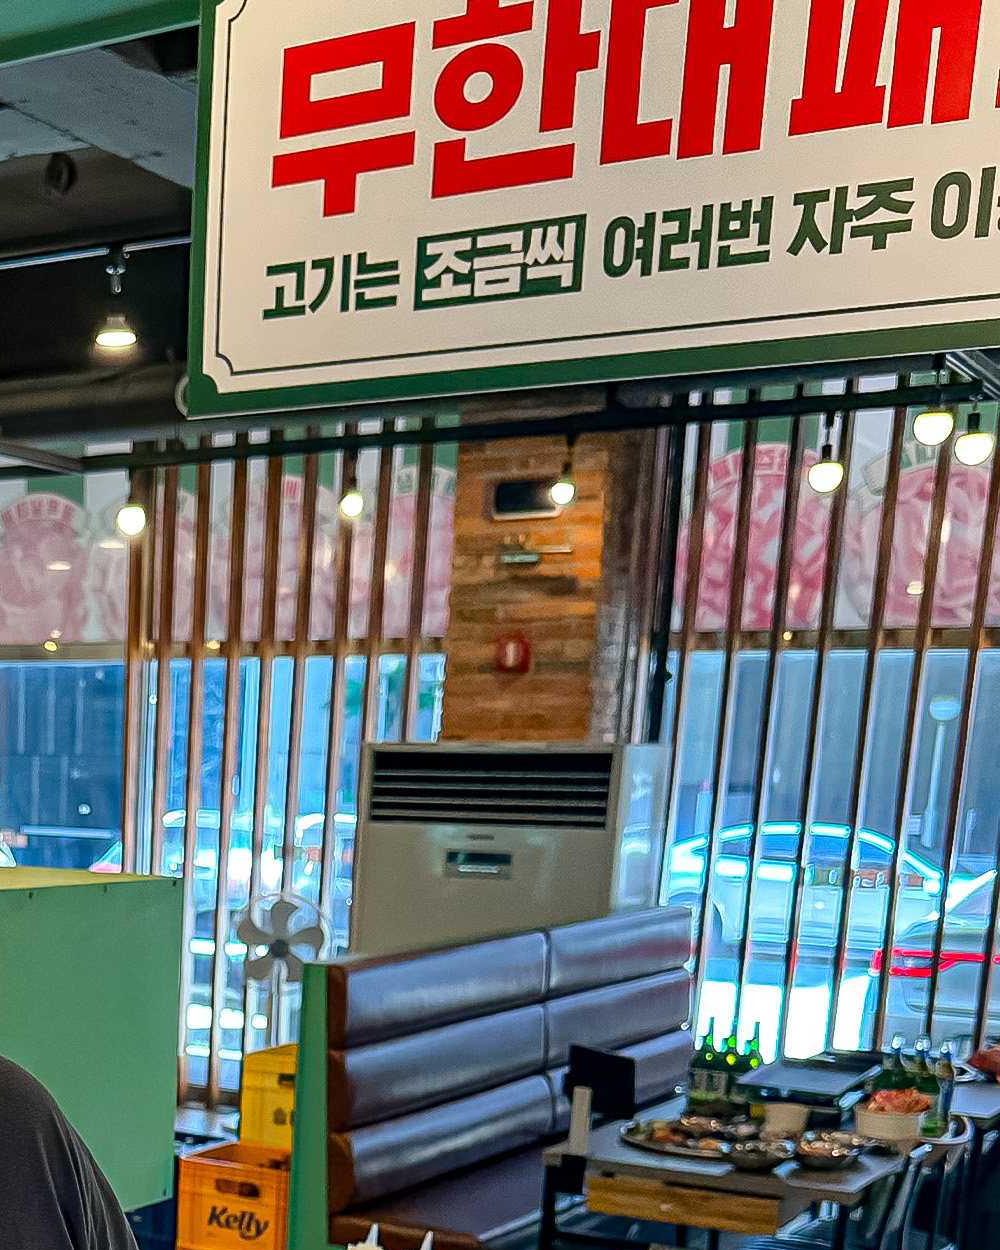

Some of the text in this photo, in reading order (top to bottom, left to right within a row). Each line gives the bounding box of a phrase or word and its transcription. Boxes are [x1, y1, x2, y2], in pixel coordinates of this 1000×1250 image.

[271, 0, 1000, 218] 무한대패
[262, 166, 1000, 320] 고기는 조금씩 여러번 자주 이
[207, 1205, 269, 1241] Kelly
